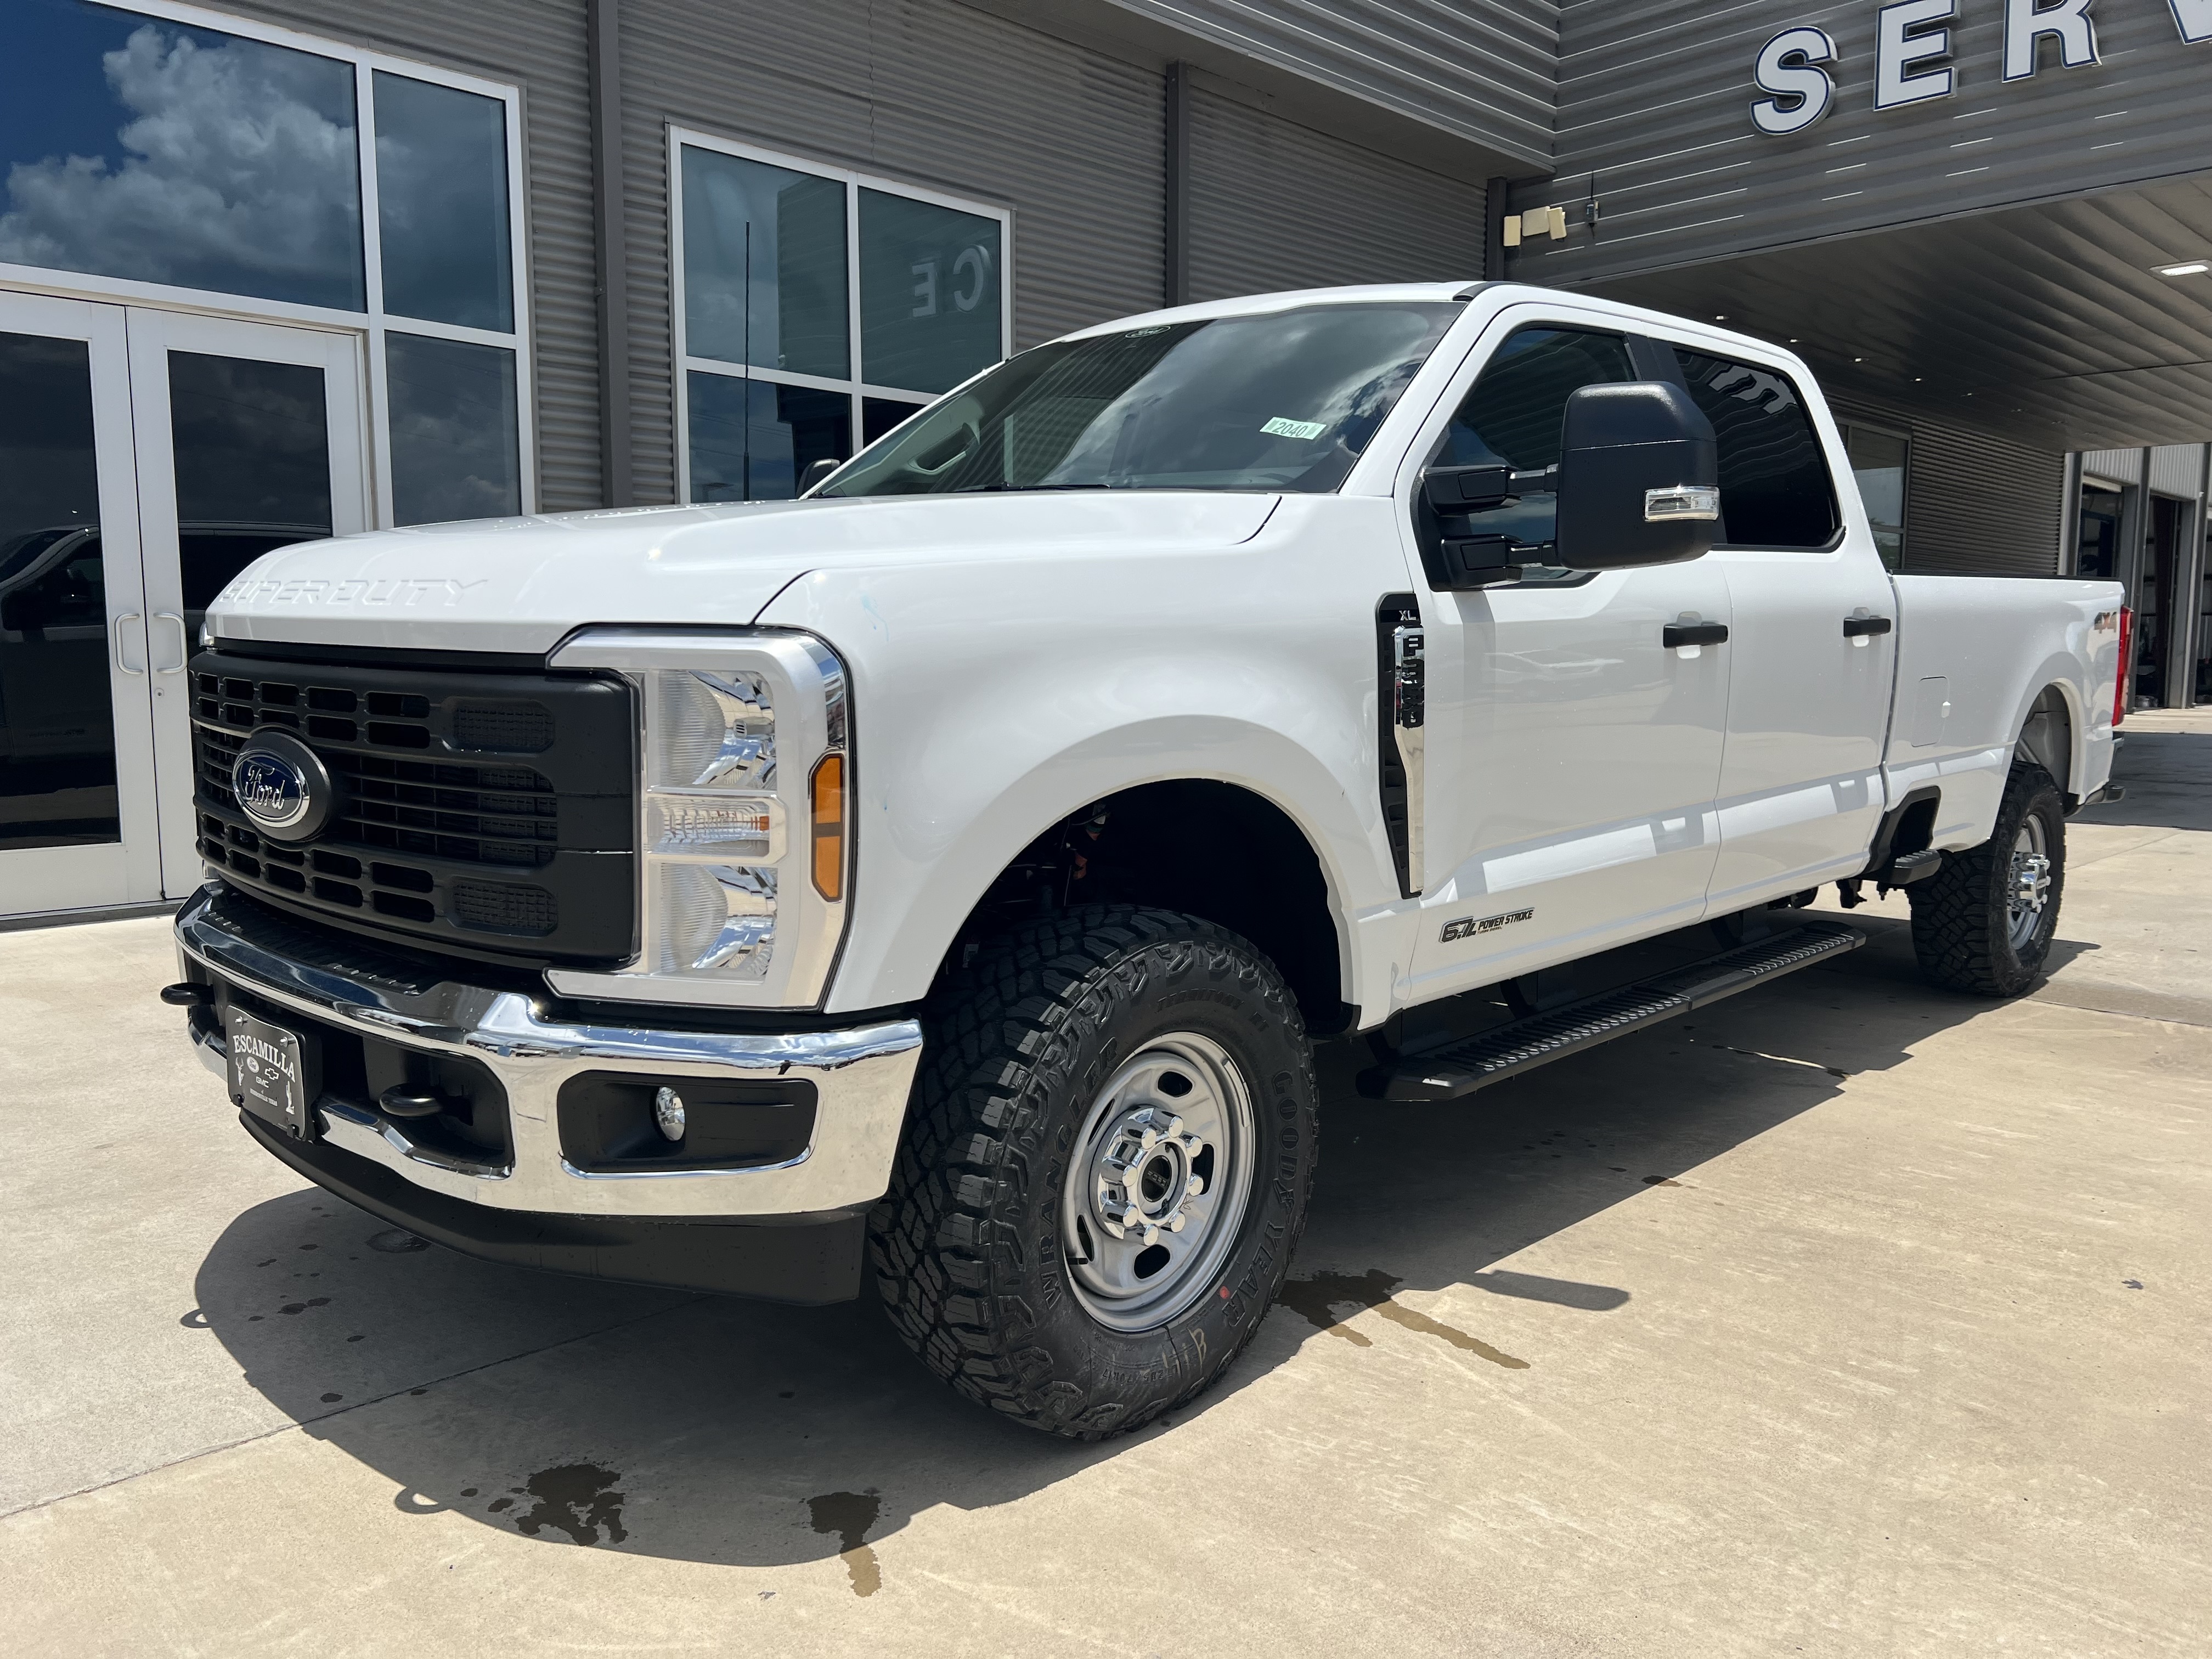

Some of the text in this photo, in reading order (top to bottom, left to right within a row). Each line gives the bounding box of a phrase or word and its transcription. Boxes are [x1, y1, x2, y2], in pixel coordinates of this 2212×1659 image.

[1272, 421, 1308, 437] 2040
[221, 579, 488, 606] SUPER DUTY
[1398, 610, 1417, 622] XL
[245, 759, 286, 810] Ford
[1441, 909, 1534, 943] 6.7L POWER STROKE
[233, 1034, 296, 1084] ESCAMILLA
[256, 1076, 269, 1088] GMC
[1221, 1070, 1299, 1327] GOODYEAR
